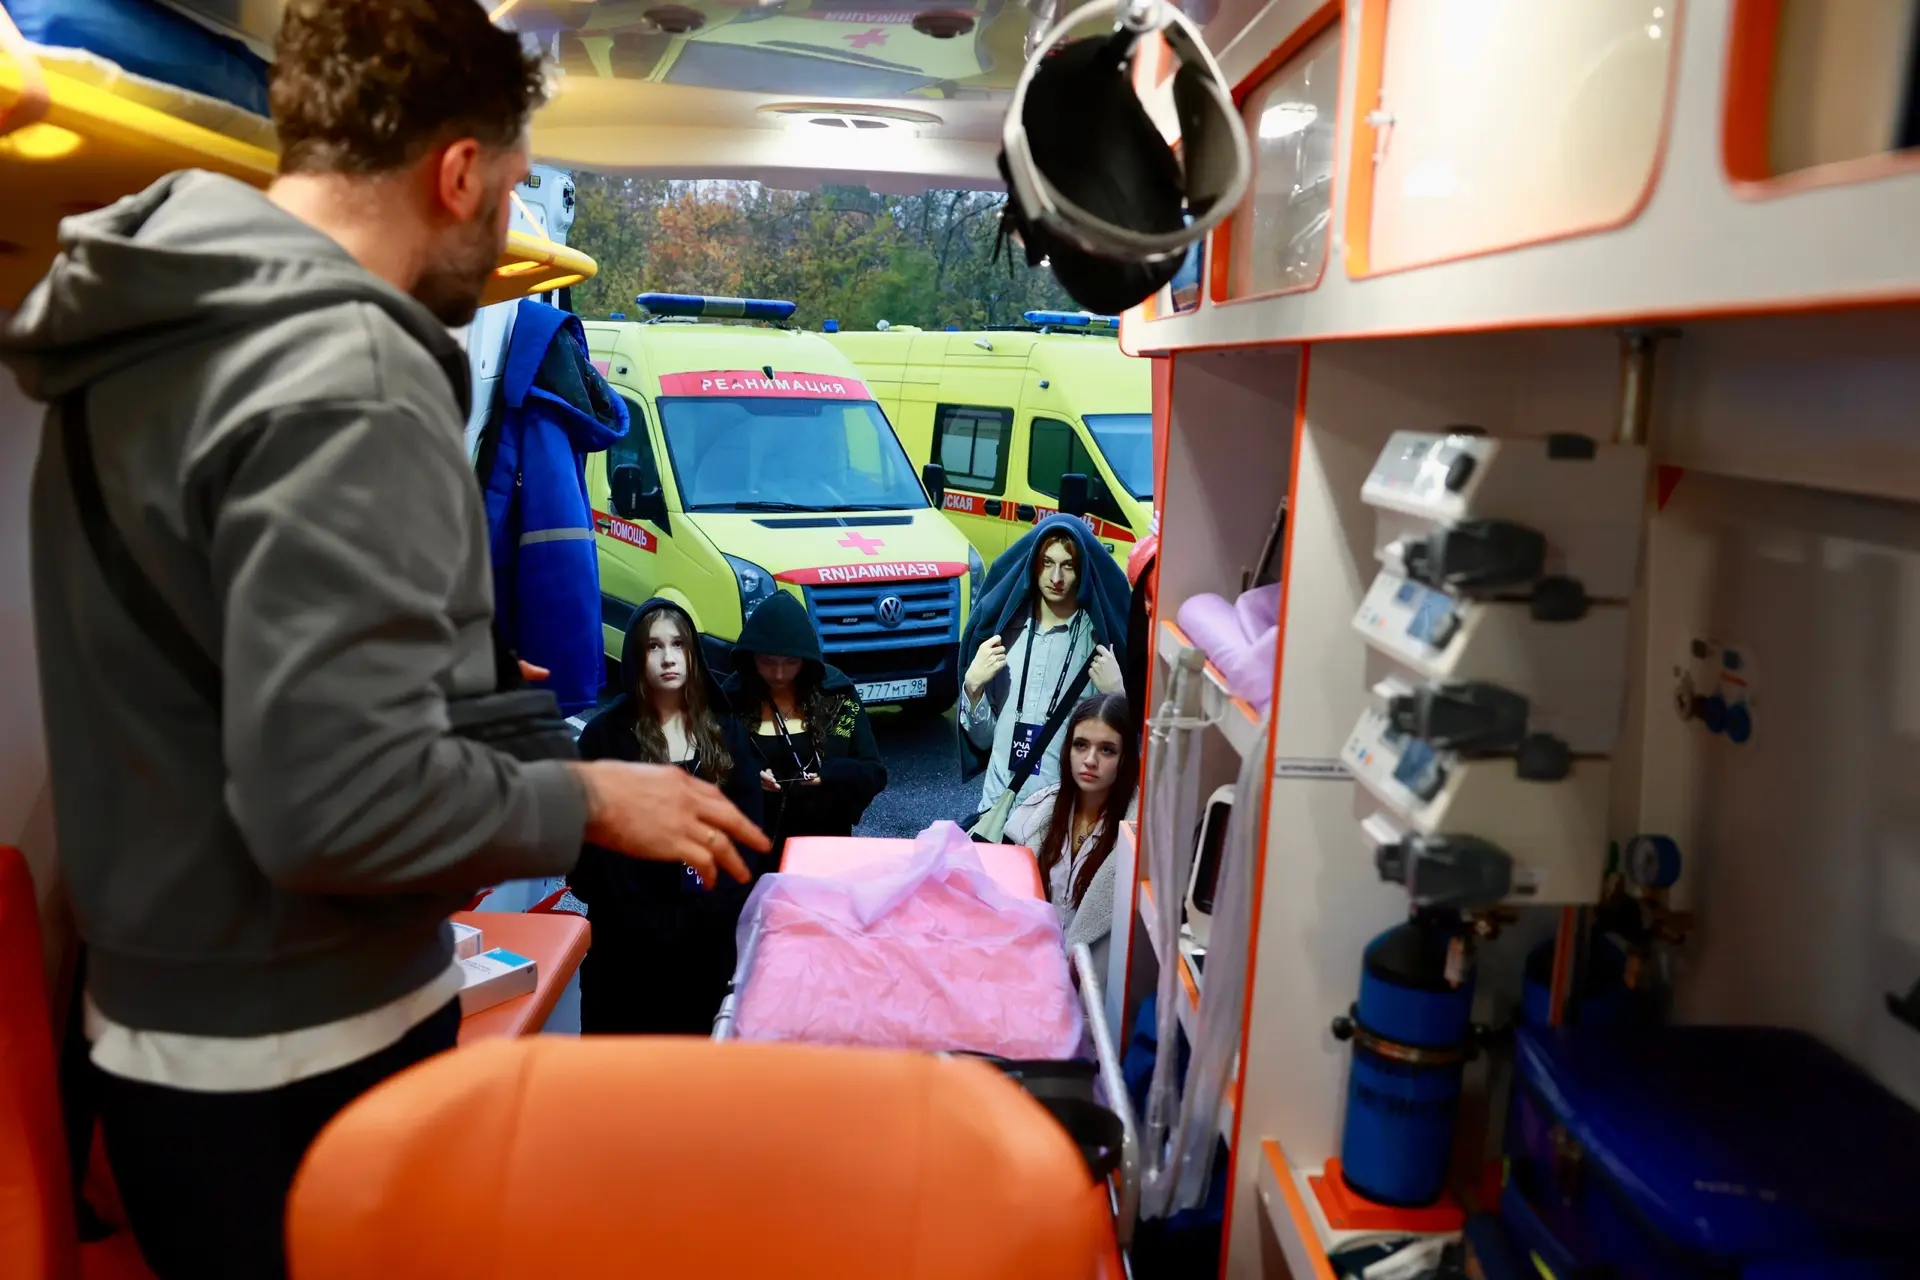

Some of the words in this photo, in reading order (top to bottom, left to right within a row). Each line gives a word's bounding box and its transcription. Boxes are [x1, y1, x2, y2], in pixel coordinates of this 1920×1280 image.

[701, 378, 846, 395] РЕАНИМАЦИЯ
[611, 520, 648, 547] ПОМОЩЬ
[1013, 741, 1030, 750] УЧА
